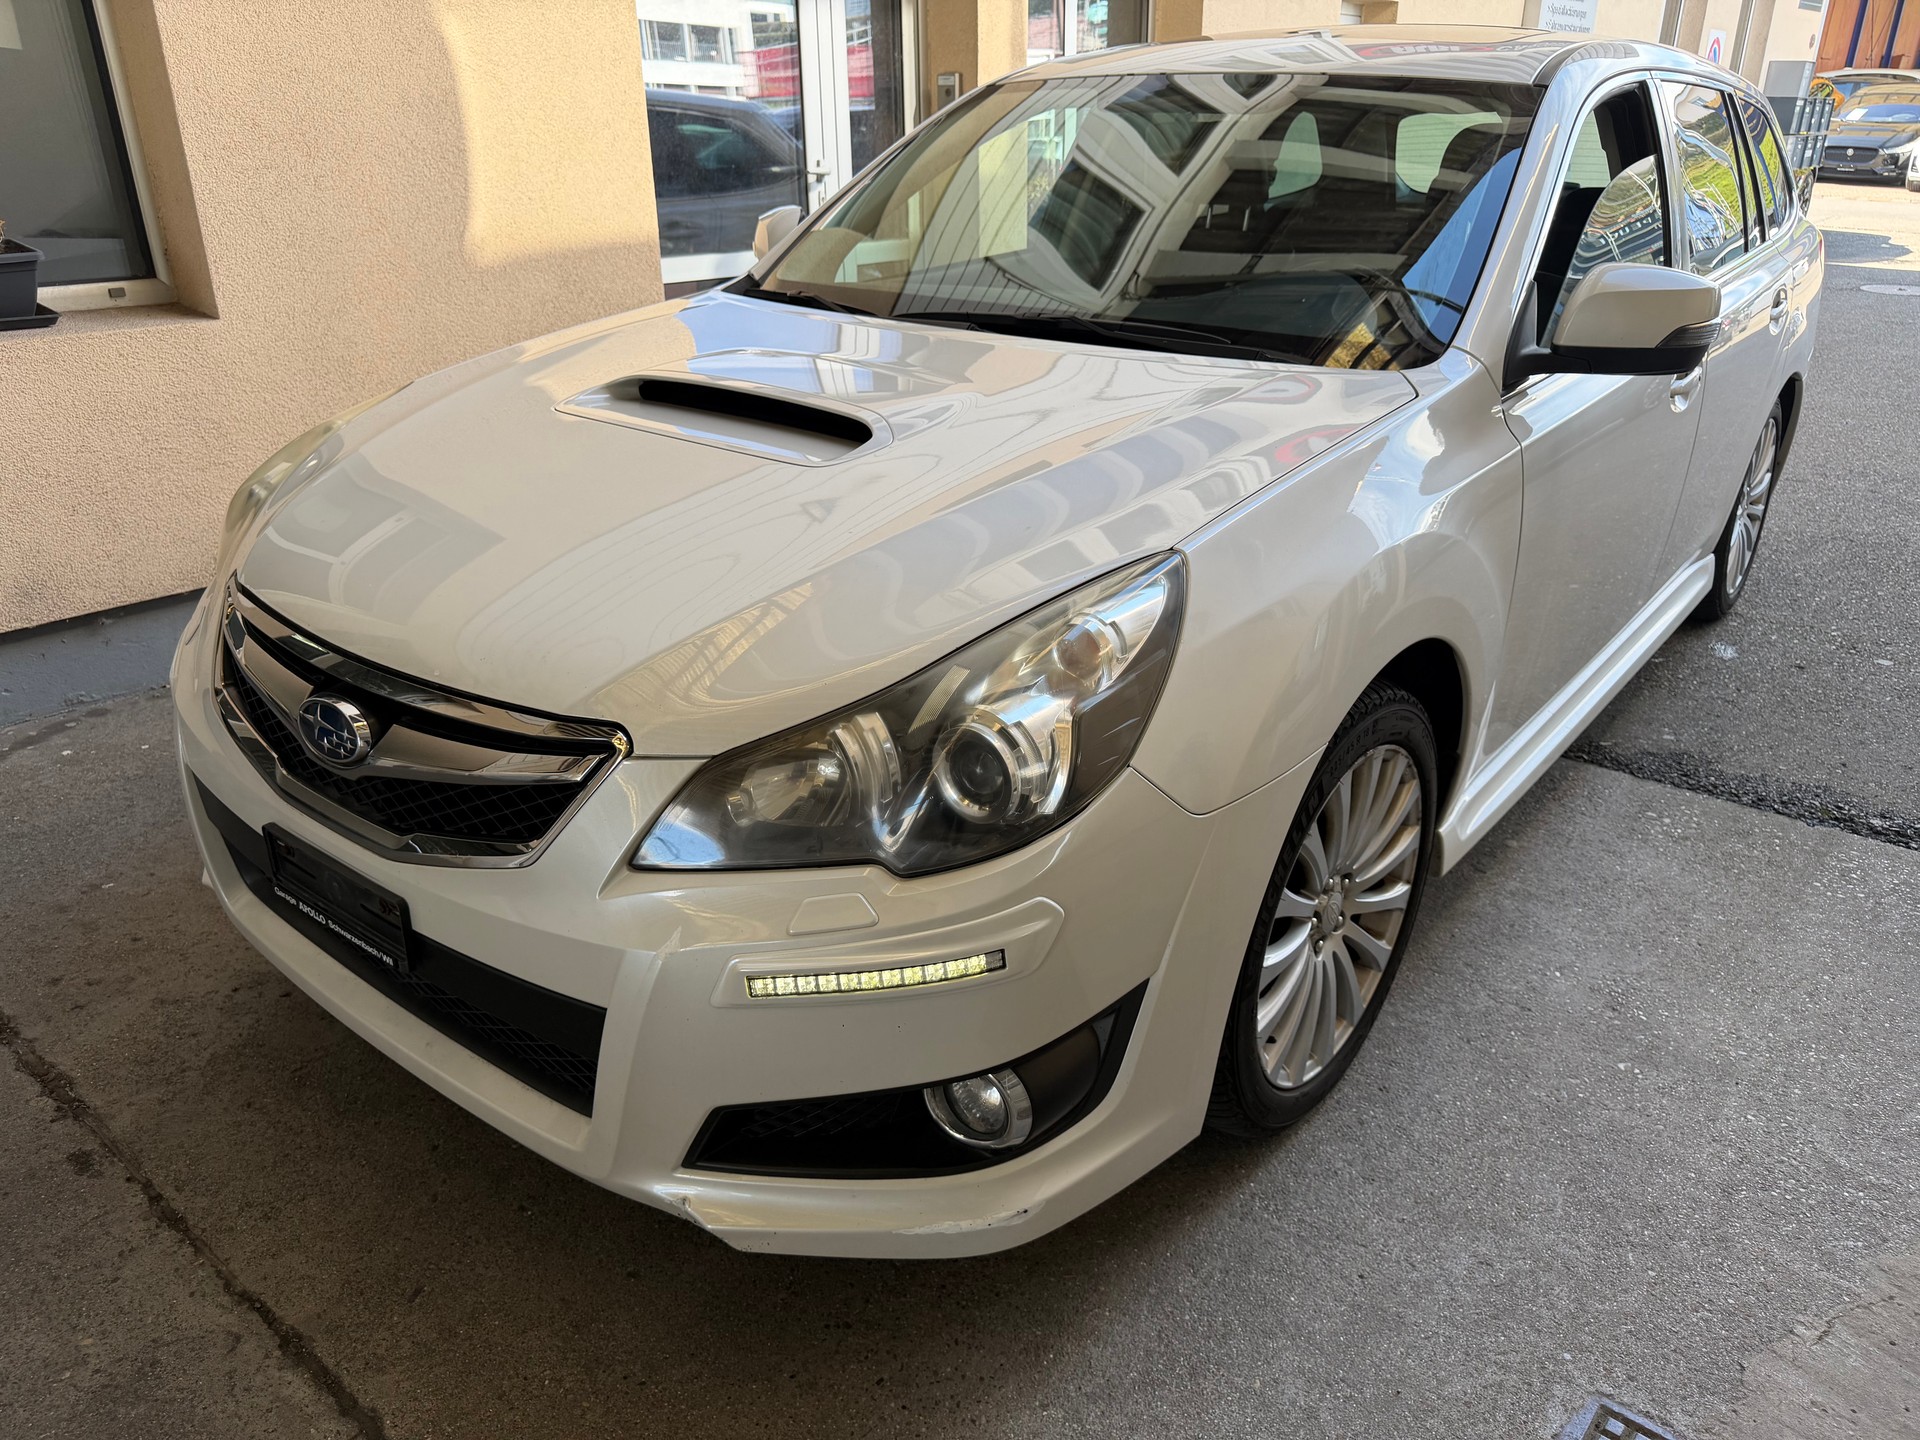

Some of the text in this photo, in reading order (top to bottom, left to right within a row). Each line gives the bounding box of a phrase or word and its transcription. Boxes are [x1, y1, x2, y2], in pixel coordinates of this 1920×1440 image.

[275, 886, 297, 905] Garage
[299, 901, 326, 925] APOLLO
[1252, 780, 1326, 954] MICHELIN
